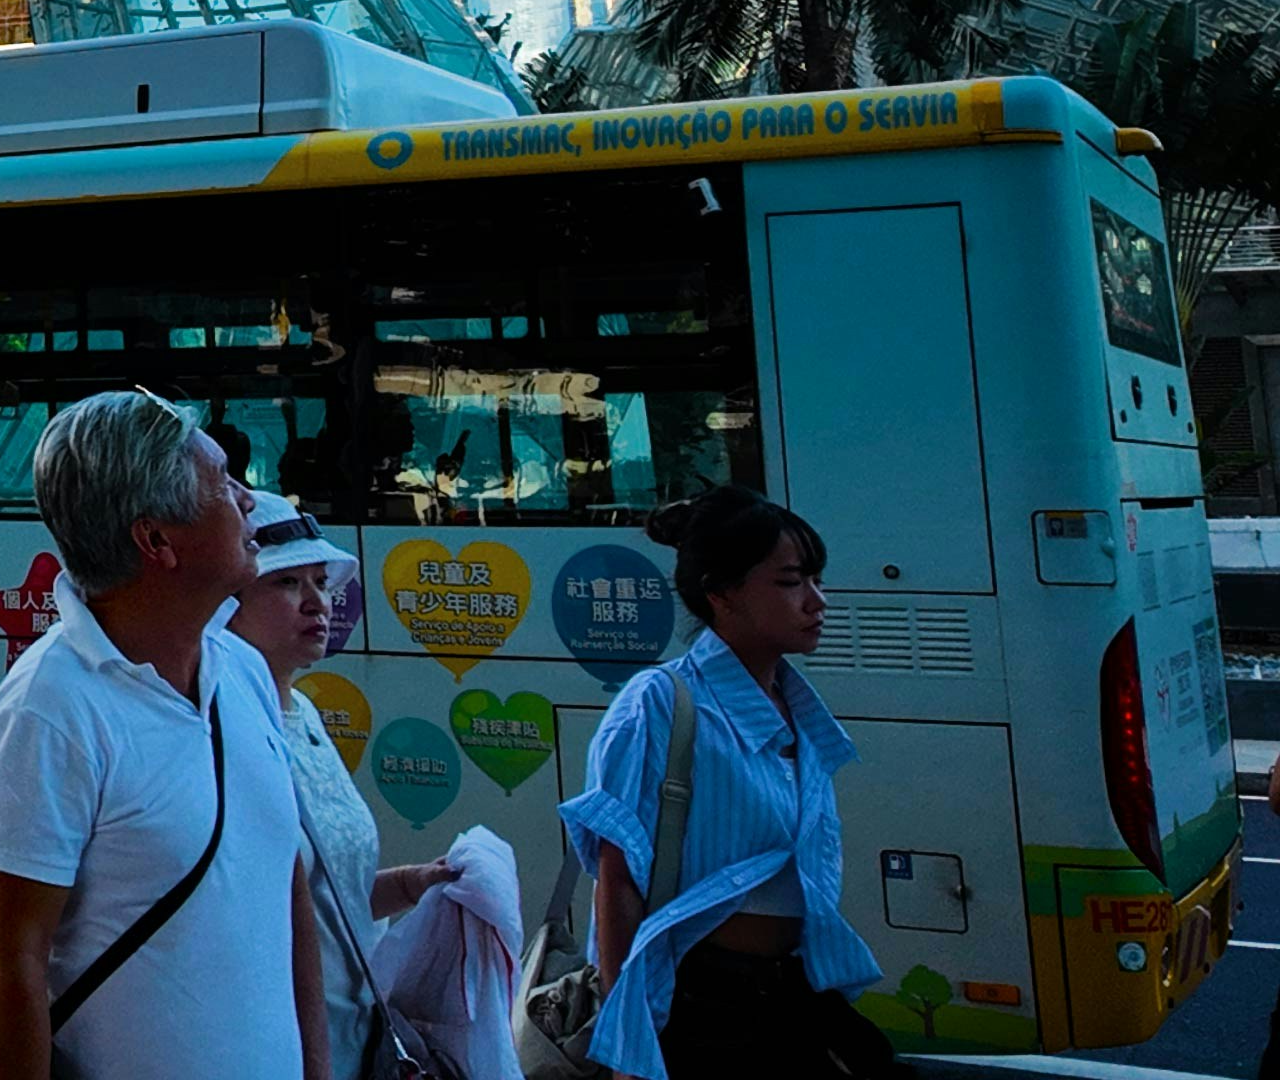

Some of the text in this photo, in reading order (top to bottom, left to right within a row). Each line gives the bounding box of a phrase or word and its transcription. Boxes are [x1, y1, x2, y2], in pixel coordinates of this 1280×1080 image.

[593, 106, 733, 151] INOVAÇÃO
[741, 103, 815, 141] PARA
[824, 101, 848, 134] O
[858, 92, 958, 131] SERVIR
[417, 560, 492, 587] 兒童及
[565, 576, 663, 601] 社會重返
[394, 589, 519, 618] 青少年服務
[591, 600, 640, 624] 服務
[627, 640, 658, 652] Social
